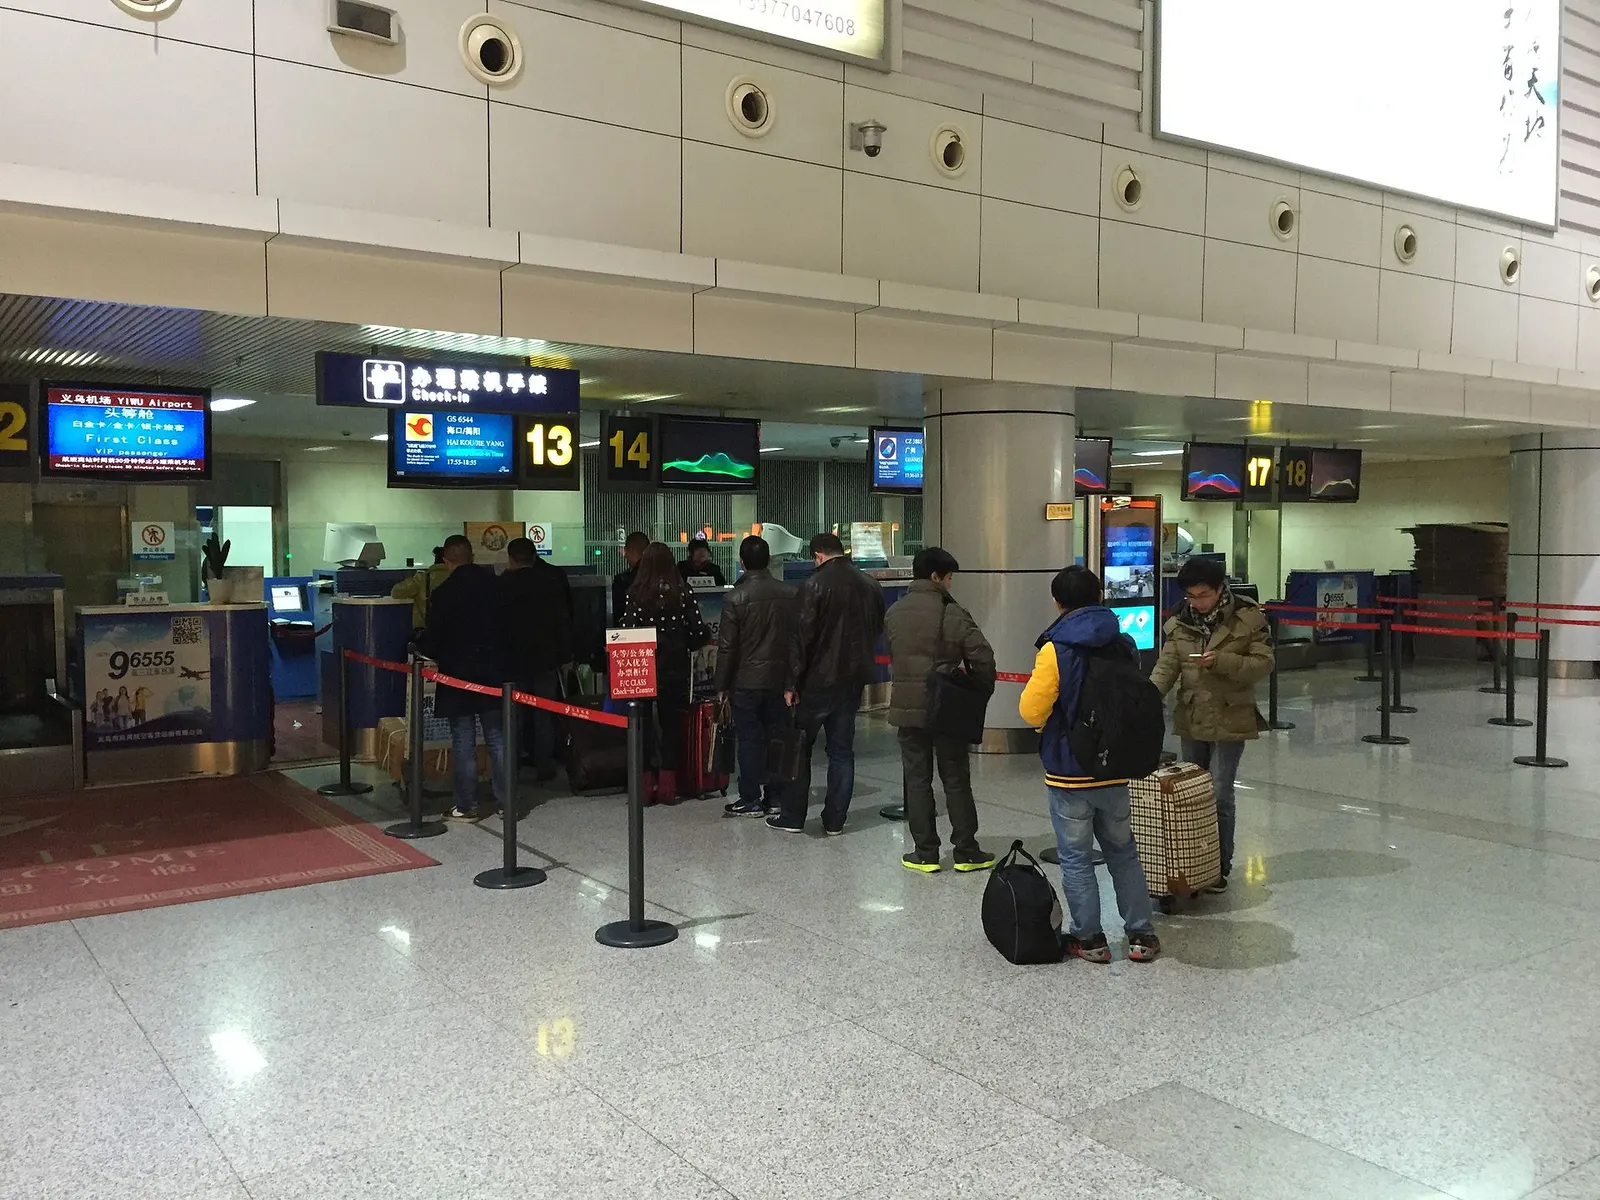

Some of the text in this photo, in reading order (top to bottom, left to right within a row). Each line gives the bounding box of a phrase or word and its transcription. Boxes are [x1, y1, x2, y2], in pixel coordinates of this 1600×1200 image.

[60, 394, 192, 410] 义乌机场 YIWU Airport
[412, 388, 470, 404] Check-in
[105, 407, 154, 420] 头等舱
[86, 434, 179, 446] First Class
[526, 423, 573, 466] 13
[610, 430, 650, 469] 14
[1248, 458, 1271, 486] 17
[1286, 460, 1306, 487] 18
[108, 650, 175, 680] 96555
